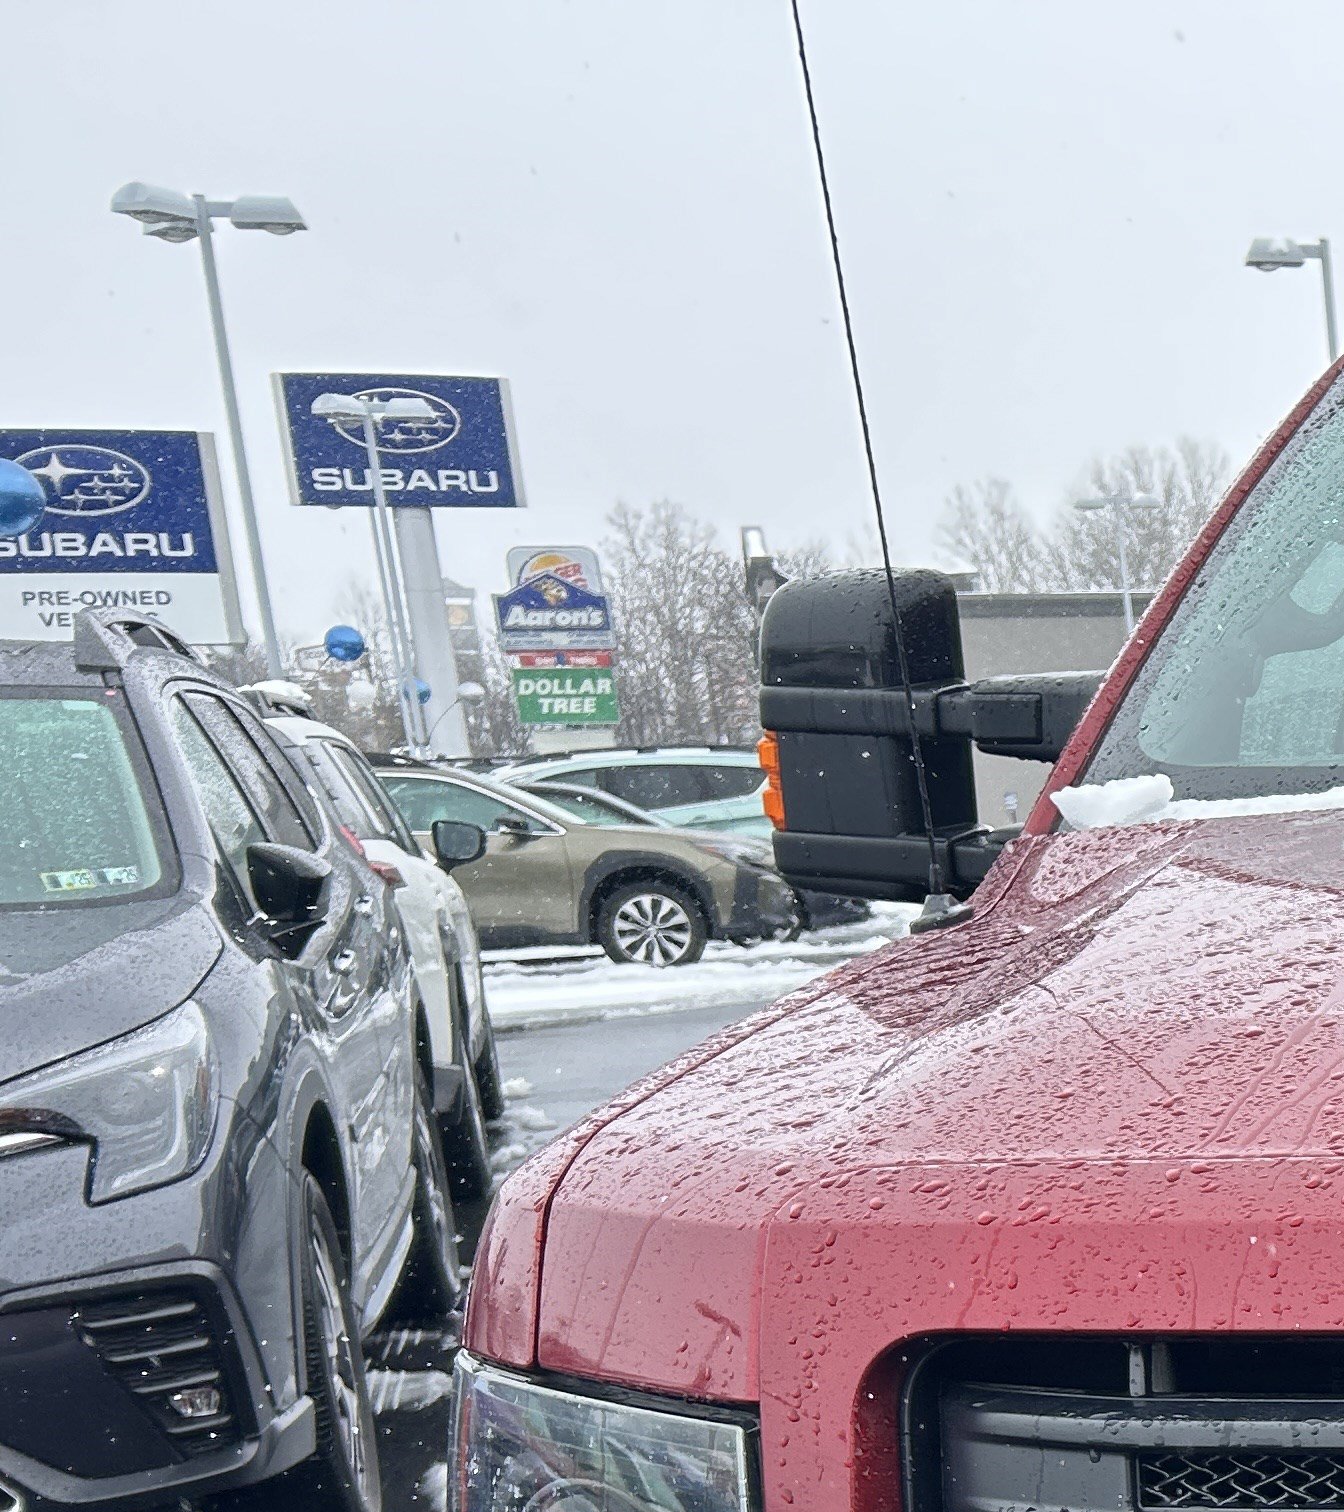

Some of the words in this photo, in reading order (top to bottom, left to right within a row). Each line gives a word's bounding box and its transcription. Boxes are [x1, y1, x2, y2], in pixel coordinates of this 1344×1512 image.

[311, 467, 499, 493] SUBARU
[22, 590, 172, 607] PRE-OWNED
[505, 605, 604, 627] Aaron's
[518, 678, 612, 695] DOLLAR
[538, 697, 598, 714] TREE
